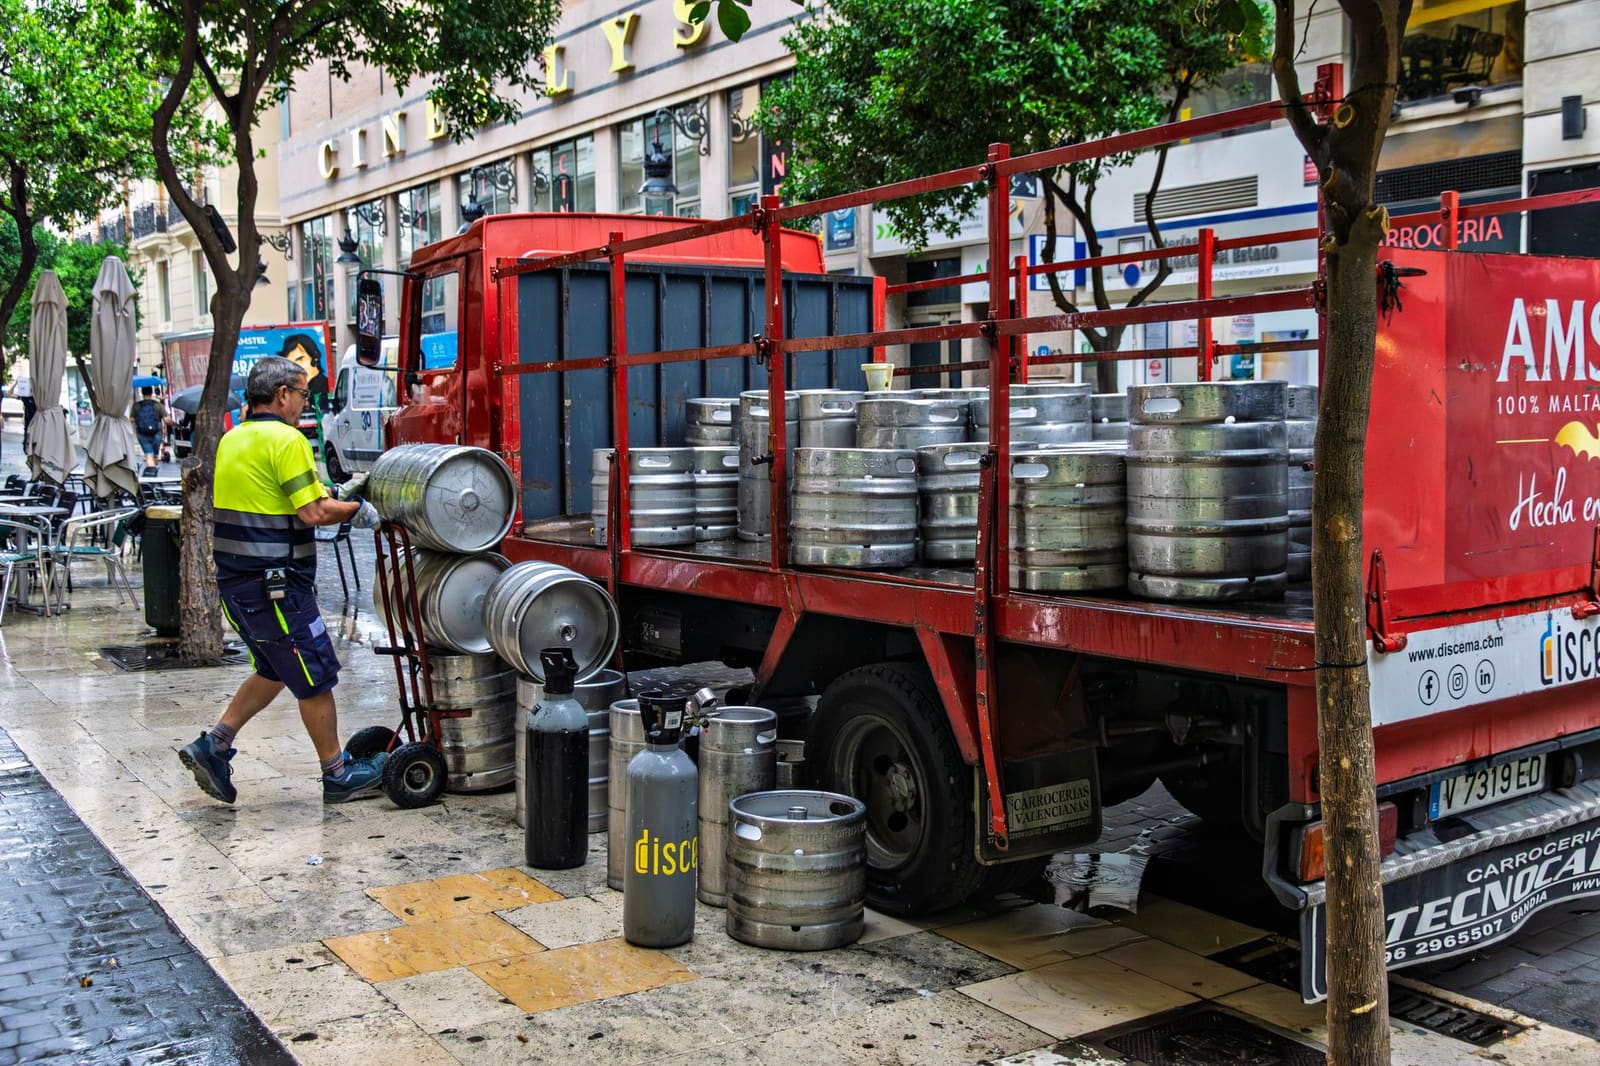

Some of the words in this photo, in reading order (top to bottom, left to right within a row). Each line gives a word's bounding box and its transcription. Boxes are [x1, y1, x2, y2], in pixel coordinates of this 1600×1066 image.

[1232, 245, 1279, 263] Estado
[232, 359, 259, 373] BRA
[1496, 395, 1540, 414] 100%
[1548, 394, 1600, 413] MALTA
[360, 411, 371, 431] 30
[1509, 466, 1577, 531] Hecha
[1408, 635, 1504, 663] www.discema.com
[1446, 778, 1457, 810] V
[1463, 762, 1513, 805] 7319
[1516, 755, 1542, 790] ED
[1015, 799, 1090, 825] VALENCIANAS
[1415, 919, 1504, 956] 2965507
[1510, 890, 1548, 924] GANDIA
